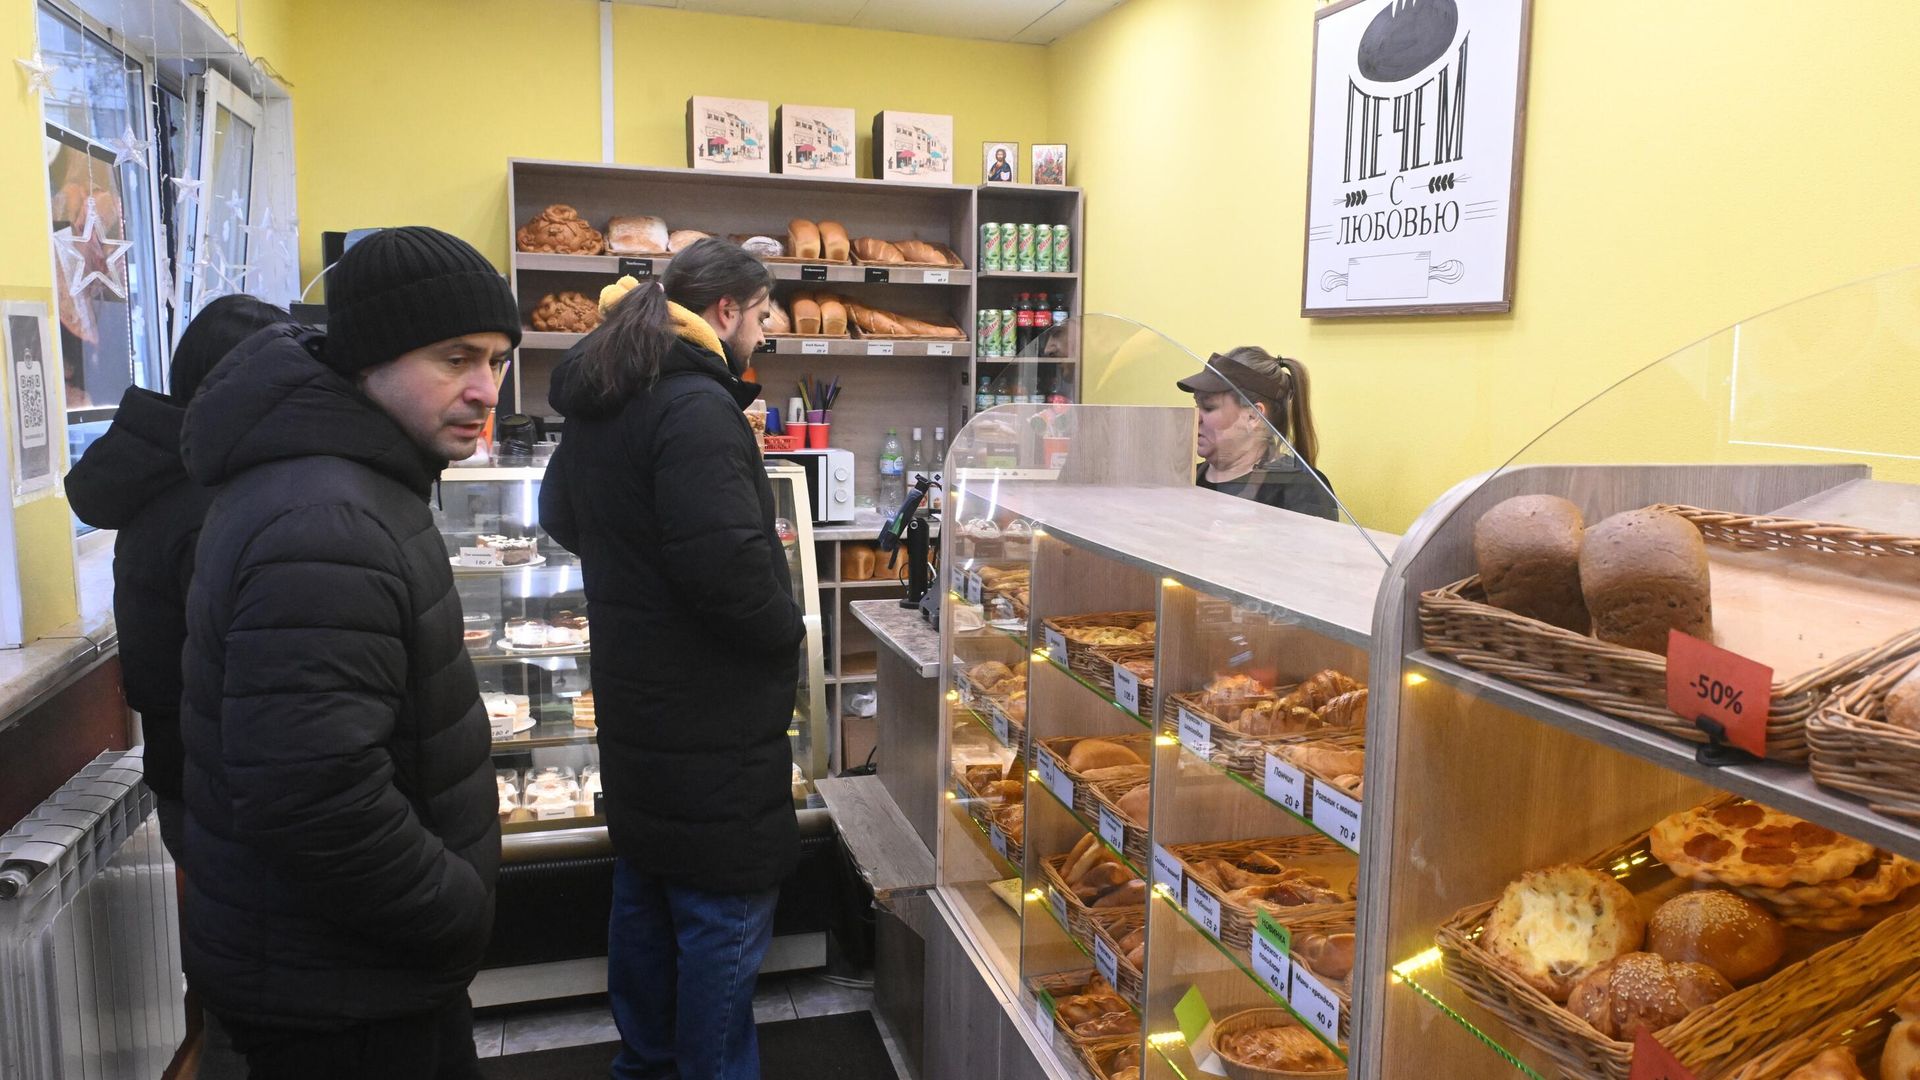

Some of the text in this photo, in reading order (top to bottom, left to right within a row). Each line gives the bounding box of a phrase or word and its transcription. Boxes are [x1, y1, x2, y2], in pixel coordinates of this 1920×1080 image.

[1342, 30, 1470, 183] ПЕЧЕМ
[1336, 200, 1460, 245] ЛЮБОВЬЮ
[1690, 674, 1743, 715] -50%
[1274, 766, 1294, 785] Пончик
[1284, 794, 1293, 807] 20
[1340, 805, 1358, 819] маком
[1340, 825, 1349, 839] 70
[1270, 974, 1278, 987] 40
[1316, 1011, 1326, 1025] 40
